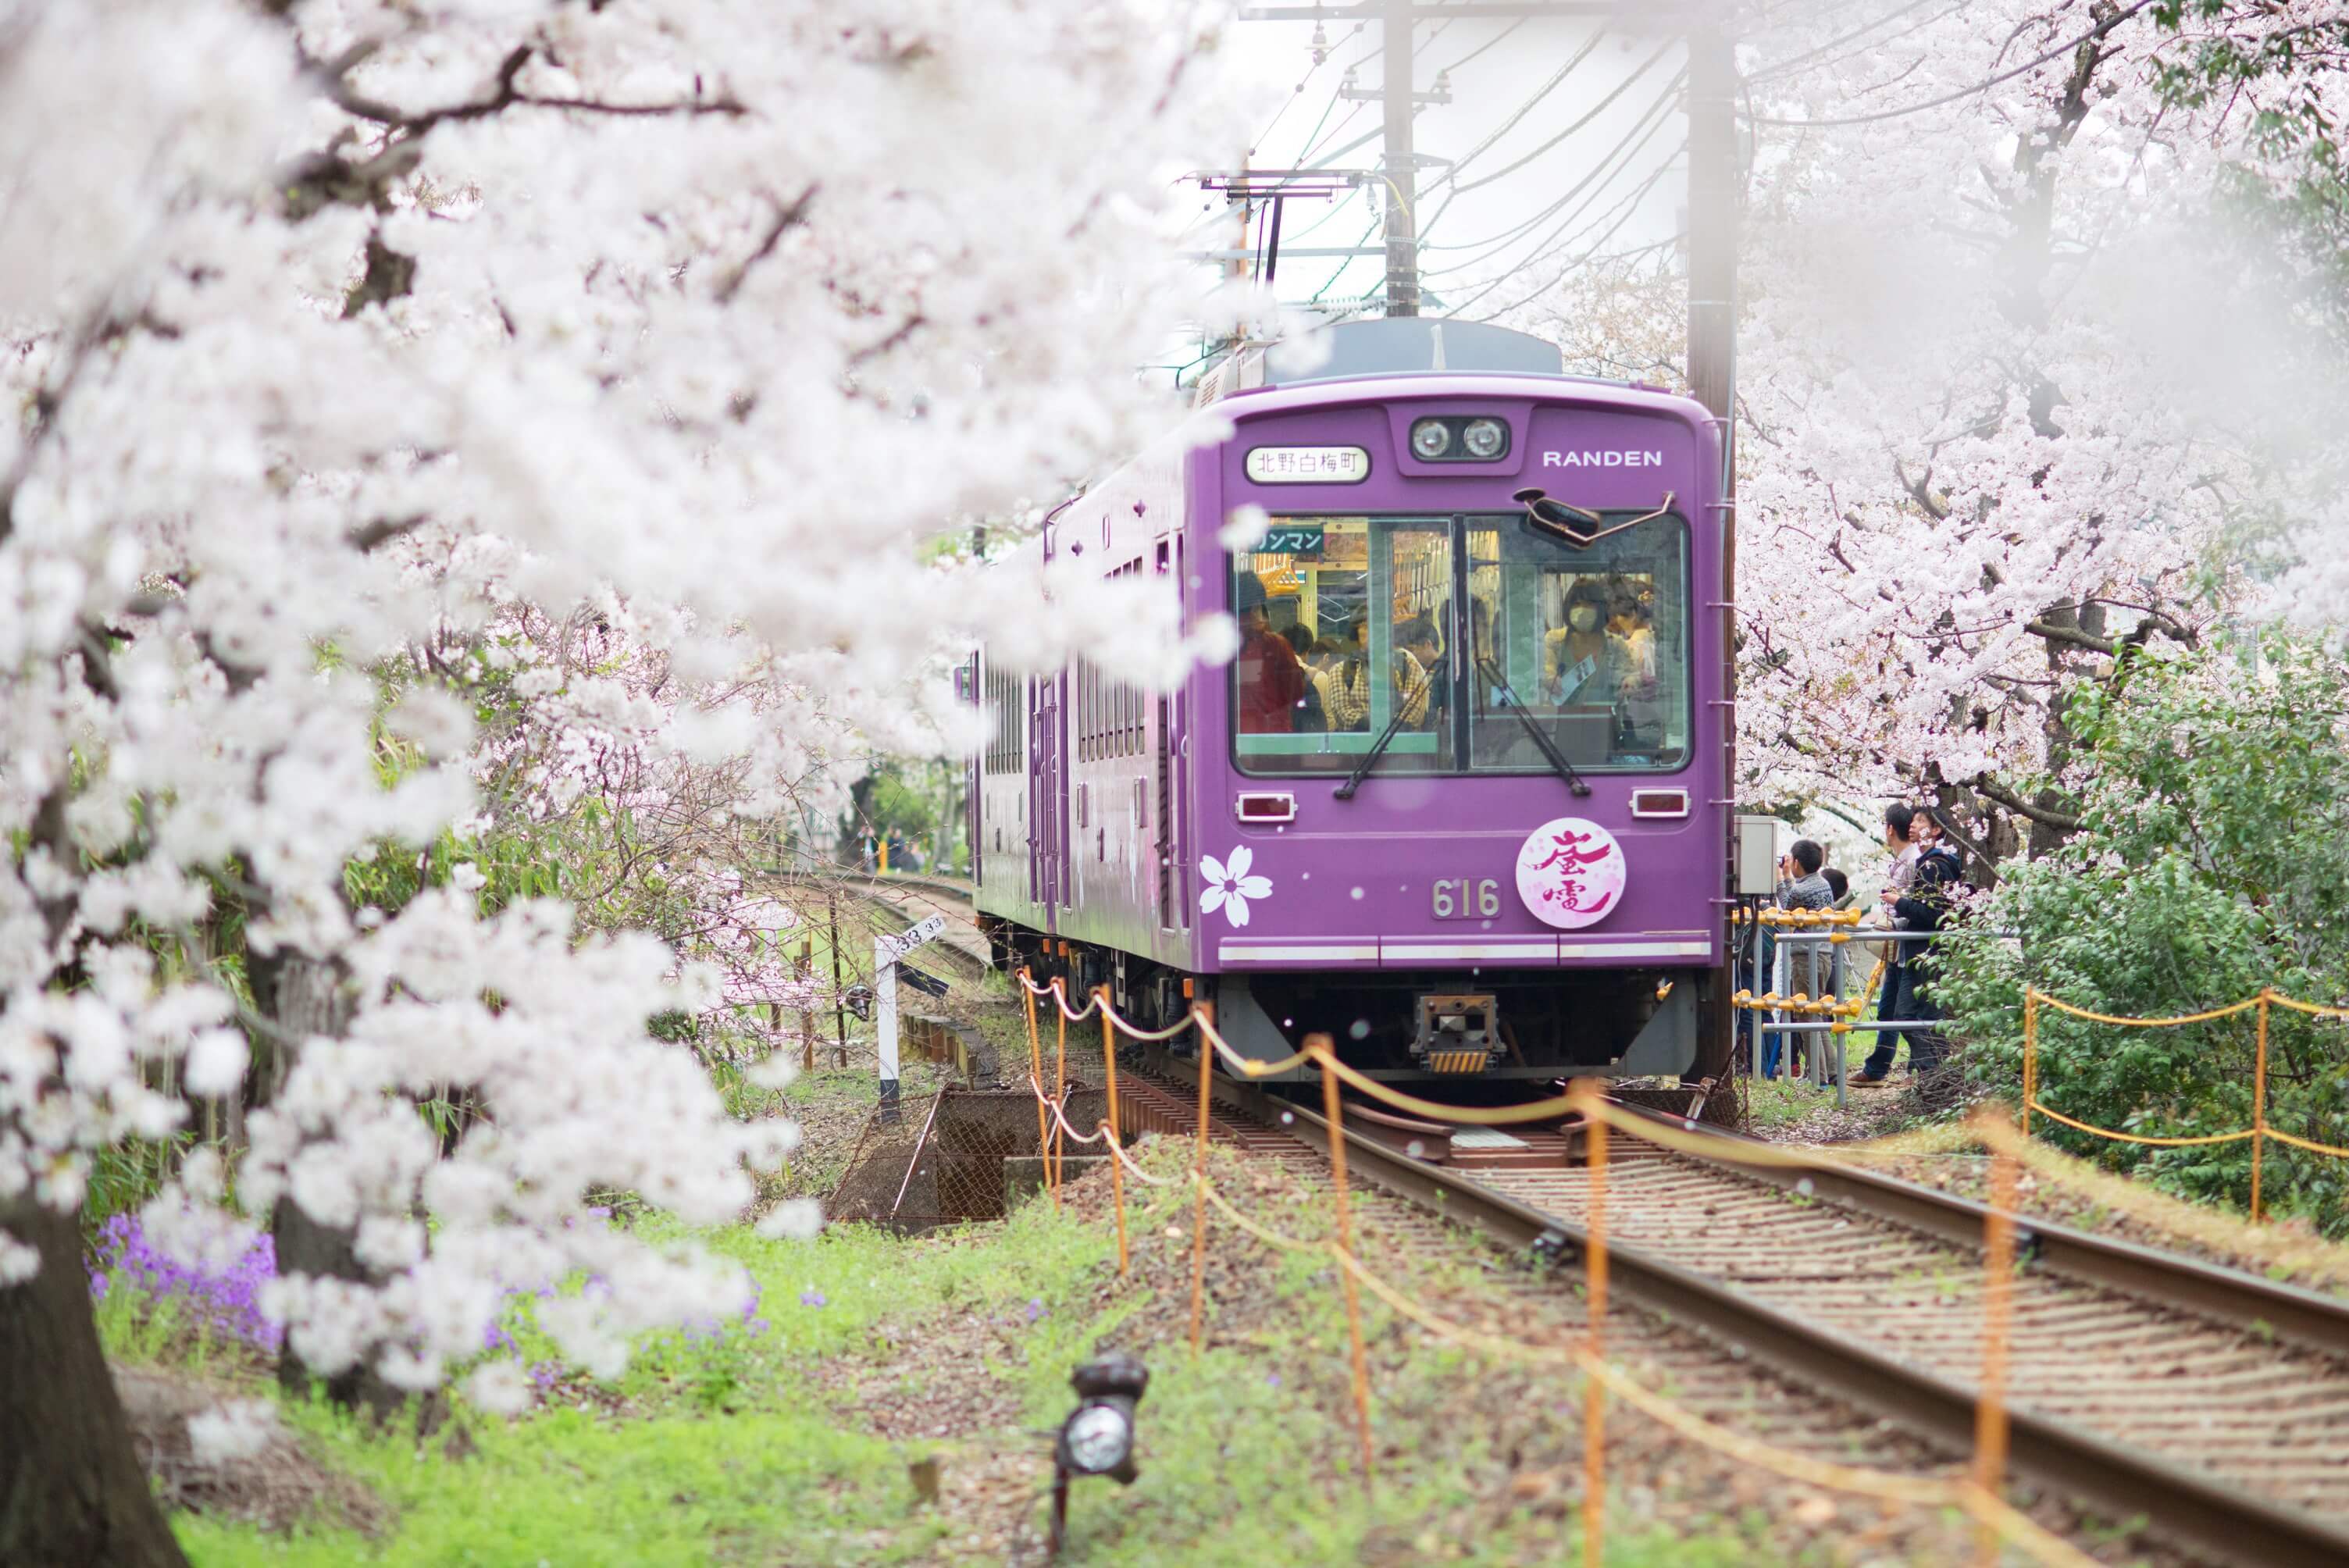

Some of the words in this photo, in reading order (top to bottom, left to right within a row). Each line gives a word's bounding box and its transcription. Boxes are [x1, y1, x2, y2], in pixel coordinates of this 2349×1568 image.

[1257, 452, 1358, 473] 北野白梅町
[1542, 451, 1663, 467] RANDEN
[1432, 878, 1499, 918] 616
